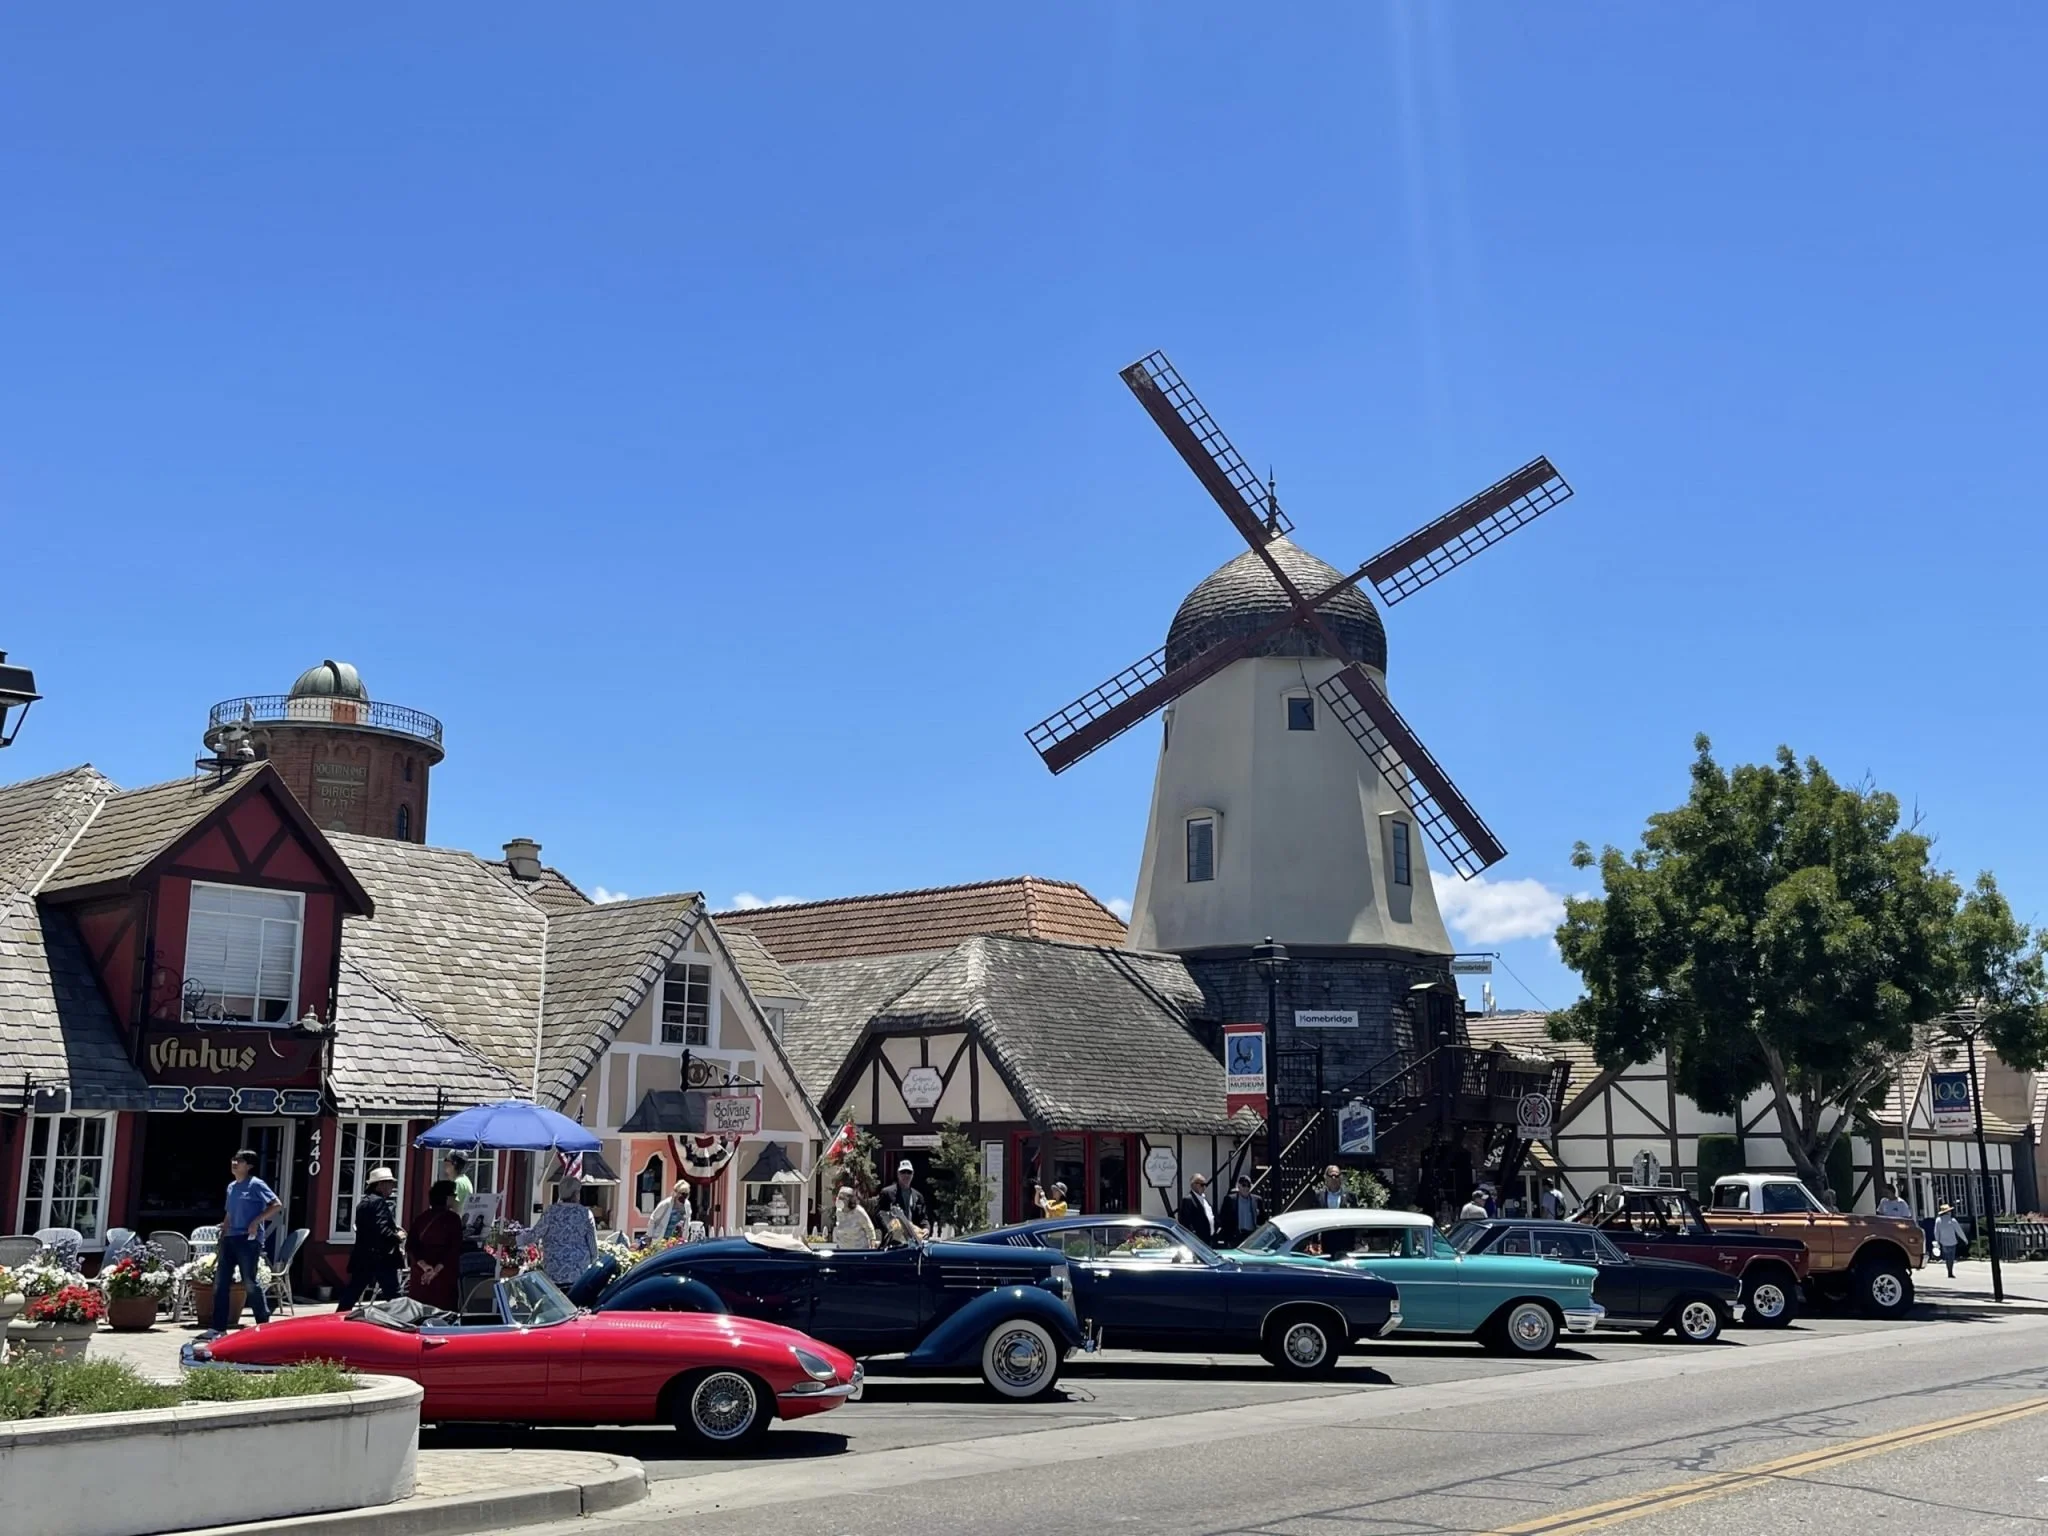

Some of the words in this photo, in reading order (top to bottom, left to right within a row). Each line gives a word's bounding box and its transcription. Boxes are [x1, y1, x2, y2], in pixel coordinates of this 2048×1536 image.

[1451, 963, 1488, 972] Homebridge
[1299, 1014, 1353, 1024] Homebridge
[149, 1037, 257, 1074] Vinhus
[1230, 1081, 1265, 1089] MUSEUM
[713, 1102, 751, 1121] Solvang
[717, 1117, 745, 1132] Bakery
[308, 1129, 321, 1175] 440
